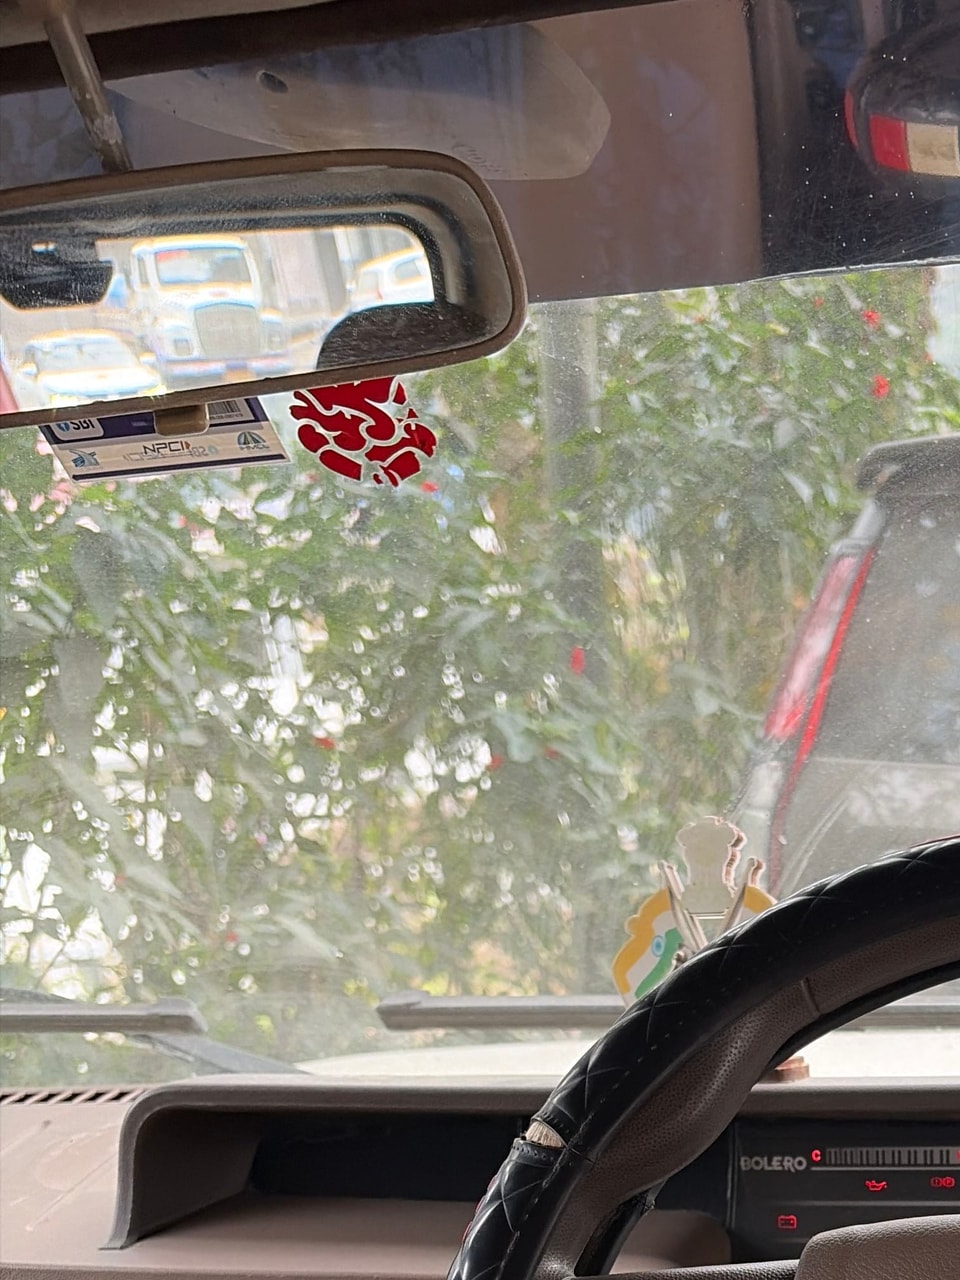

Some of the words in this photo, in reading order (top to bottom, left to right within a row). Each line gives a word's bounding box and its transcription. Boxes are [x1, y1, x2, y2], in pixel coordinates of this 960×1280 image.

[142, 440, 185, 455] NPCI
[811, 1149, 822, 1162] C
[740, 1156, 807, 1172] BOLERO
